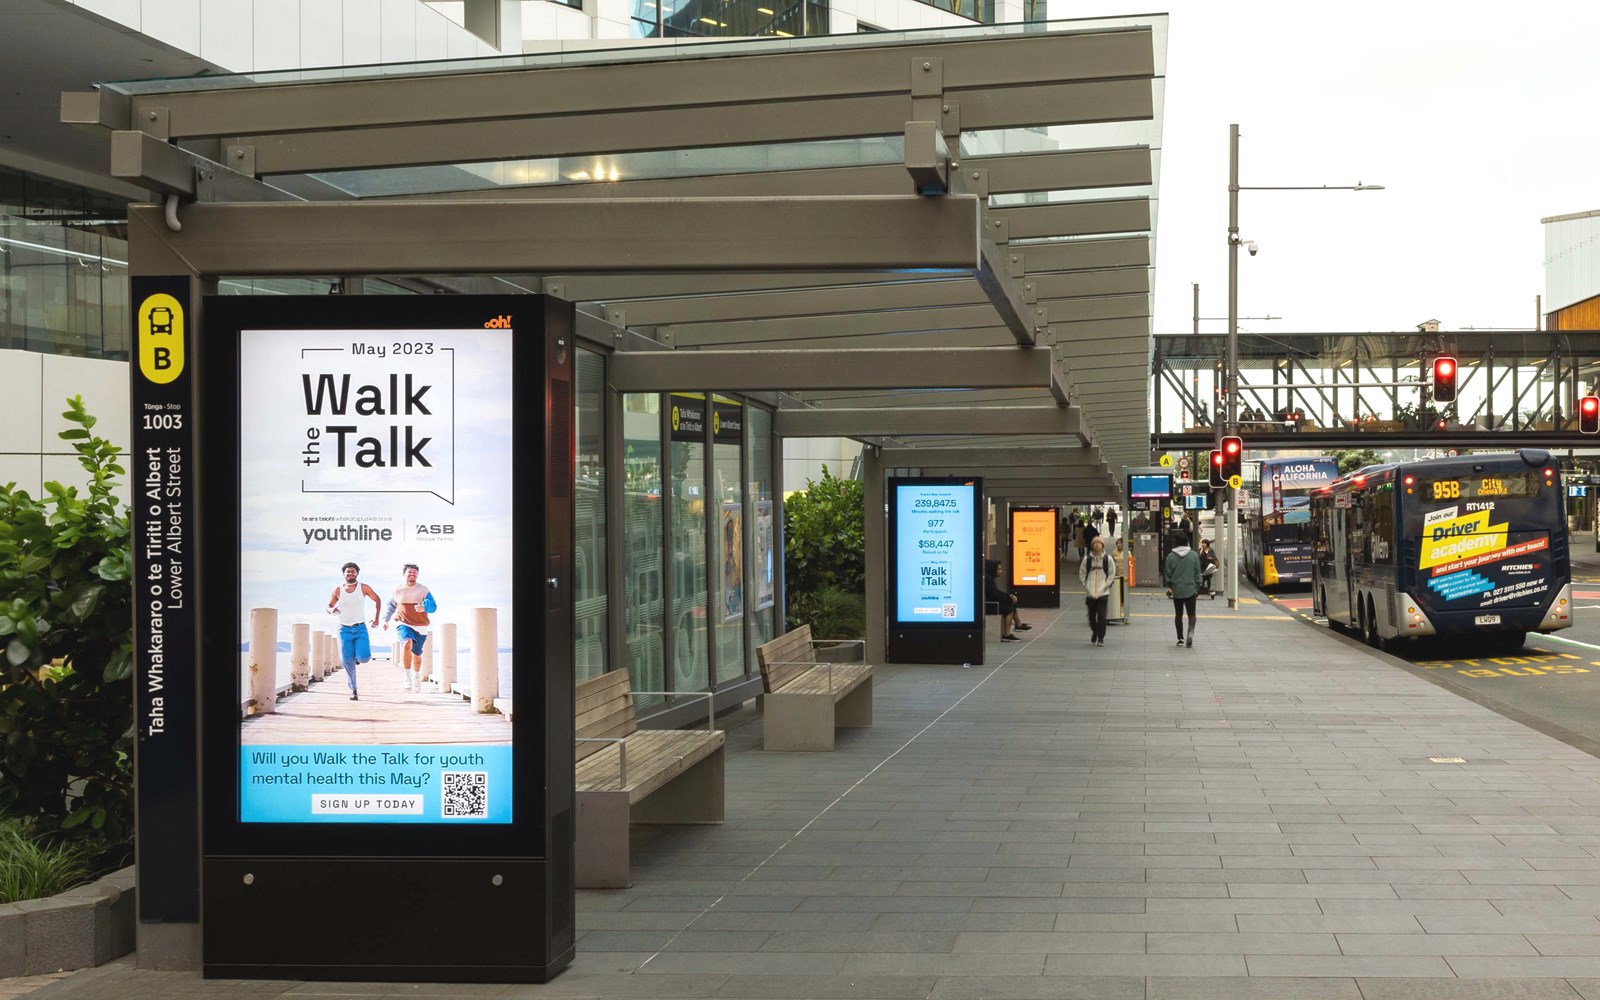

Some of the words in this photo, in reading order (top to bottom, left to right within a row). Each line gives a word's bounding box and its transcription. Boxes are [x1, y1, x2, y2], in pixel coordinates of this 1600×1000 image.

[154, 347, 171, 370] B
[352, 343, 386, 358] May
[392, 343, 434, 355] 2023
[302, 374, 433, 416] Walk
[166, 403, 181, 411] Stop
[143, 414, 182, 430] 1003
[302, 427, 320, 466] the
[325, 426, 433, 468] Talk
[145, 447, 162, 500] Albert
[166, 447, 181, 497] Street
[1272, 472, 1328, 481] CALIFORNIA
[1284, 464, 1315, 473] ALOHA
[1433, 480, 1460, 500] 95B
[1481, 478, 1503, 490] City
[149, 505, 162, 516] o
[915, 499, 957, 508] 239,847.5
[1466, 502, 1495, 511] RT1412
[1428, 514, 1442, 522] Join
[166, 502, 182, 554] Albert
[303, 525, 393, 544] youthline
[1433, 520, 1480, 542] Driver
[146, 520, 162, 559] Tiriti
[918, 540, 954, 549] $58,447
[1431, 533, 1498, 559] academy
[1435, 564, 1448, 574] and
[1448, 561, 1462, 571] start
[1463, 558, 1477, 568] your
[1477, 552, 1501, 565] journey
[1502, 547, 1515, 557] with
[1515, 546, 1527, 554] our
[1527, 540, 1545, 551] team!
[148, 563, 162, 581] te
[921, 566, 947, 576] Walk
[1501, 563, 1533, 571] RITCHIES
[168, 558, 183, 609] Lower
[926, 577, 947, 586] Talk
[1492, 587, 1504, 596] 027
[1515, 582, 1526, 591] 550
[1526, 580, 1538, 588] now
[150, 584, 163, 596] o
[148, 600, 164, 692] Whakararo
[1412, 656, 1560, 669] STOP
[1457, 665, 1591, 678] BUS
[149, 697, 164, 736] Taha
[252, 752, 277, 765] Will
[281, 754, 308, 767] you
[314, 752, 347, 765] Walk
[352, 752, 376, 765] the
[381, 752, 409, 765] Talk
[414, 752, 435, 765] for
[440, 752, 484, 768] youth
[252, 772, 302, 785] mental
[307, 772, 354, 785] health
[358, 772, 386, 785] this
[390, 772, 431, 788] May?
[320, 799, 349, 808] SIGN
[355, 799, 370, 808] UP
[376, 799, 416, 808] TODAY
